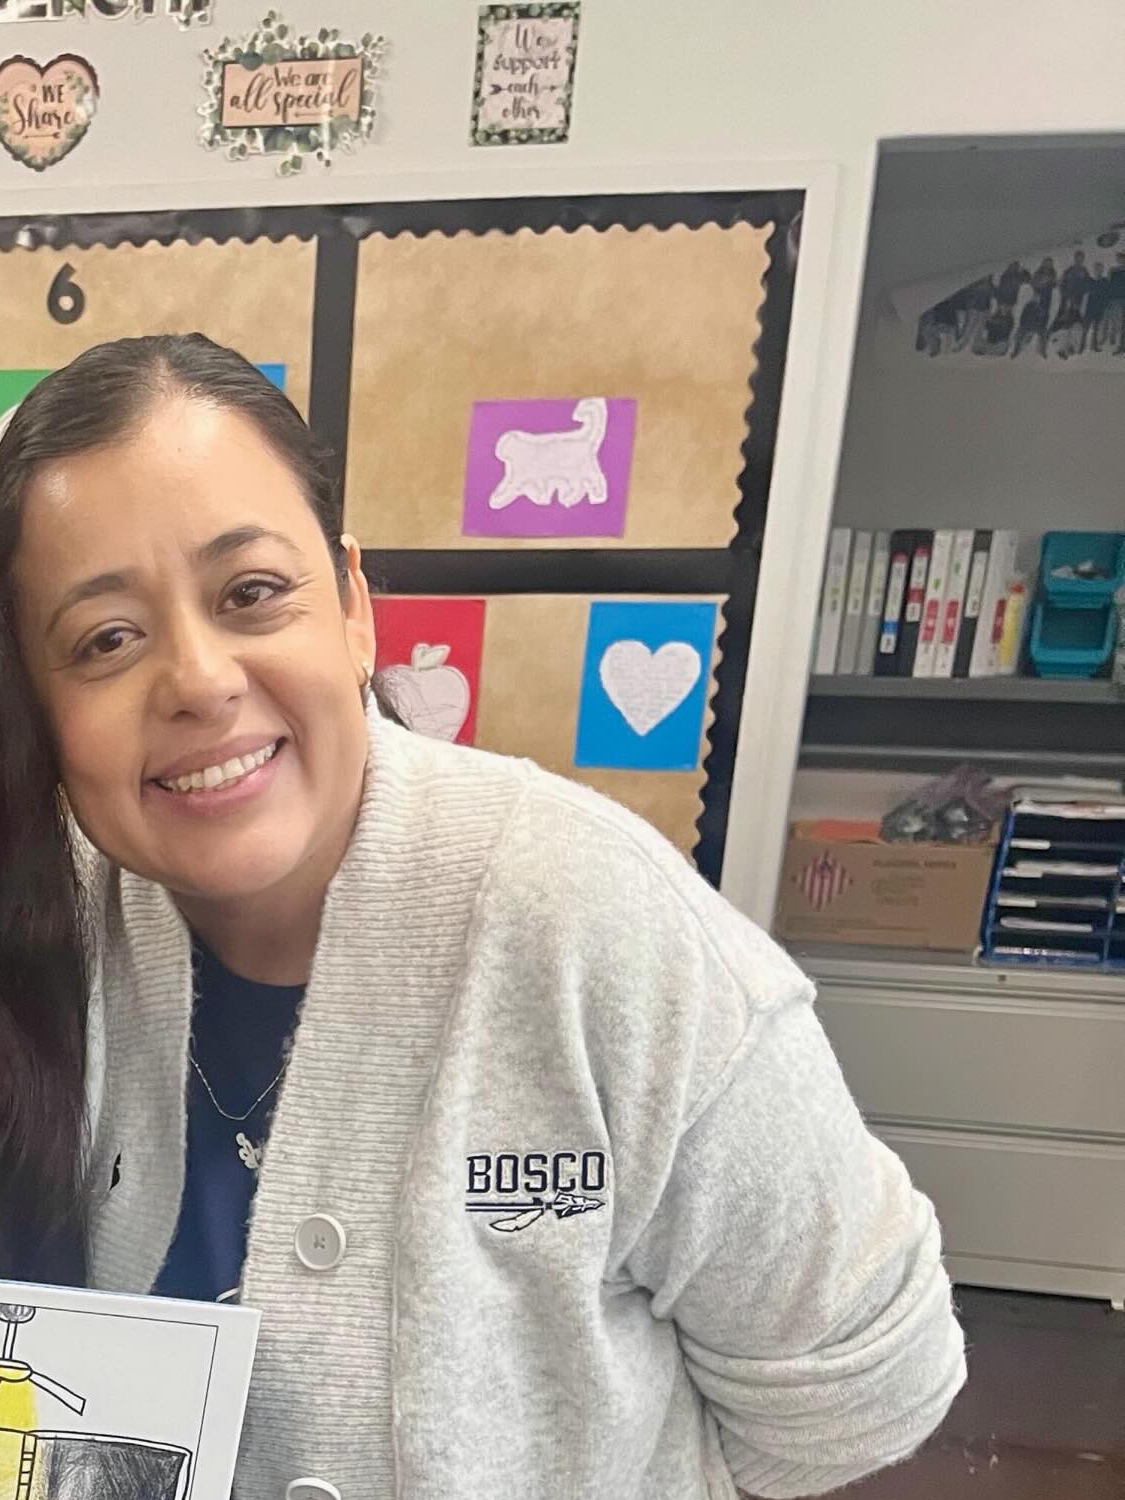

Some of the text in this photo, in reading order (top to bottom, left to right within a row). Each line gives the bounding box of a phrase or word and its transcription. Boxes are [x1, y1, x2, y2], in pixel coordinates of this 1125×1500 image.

[274, 66, 301, 87] We
[493, 51, 561, 75] support
[42, 84, 64, 103] WE
[230, 67, 358, 124] all special
[507, 73, 539, 96] each
[11, 93, 75, 136] Share
[47, 262, 86, 325] 6
[466, 1151, 605, 1194] BOSCO
